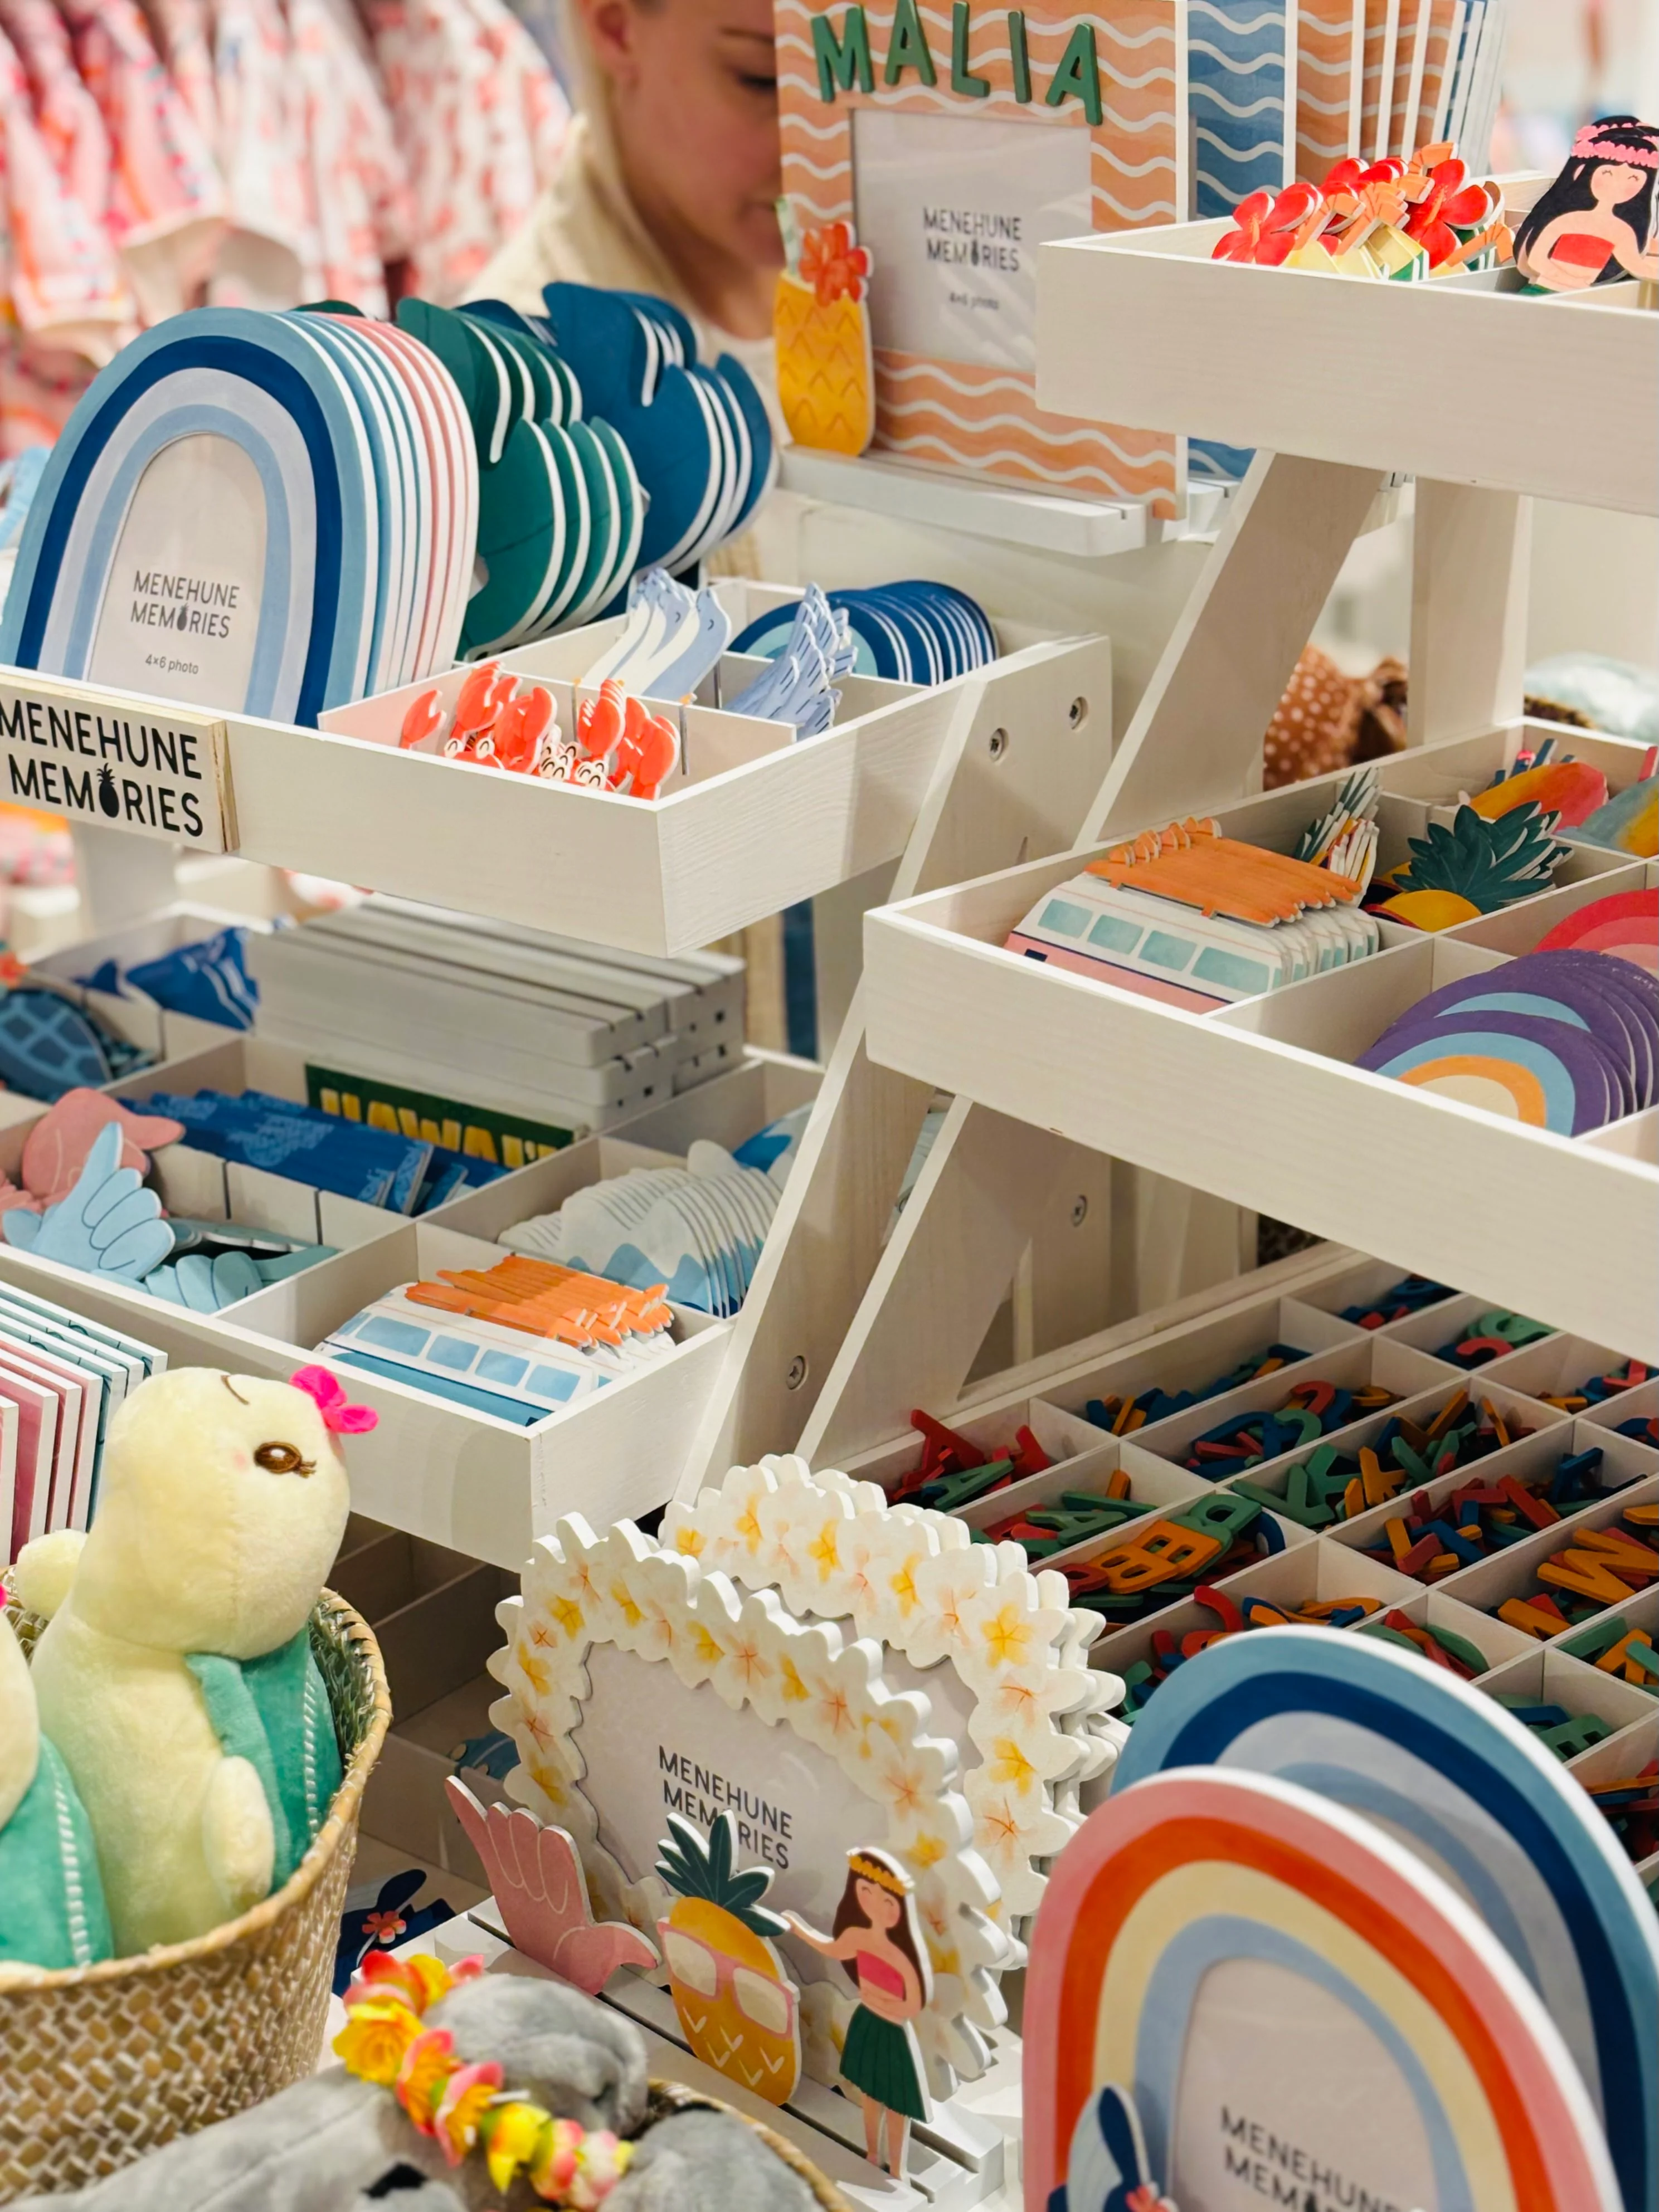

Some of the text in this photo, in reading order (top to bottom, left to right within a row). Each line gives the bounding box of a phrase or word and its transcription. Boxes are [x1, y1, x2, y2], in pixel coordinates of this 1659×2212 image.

[810, 0, 1103, 126] MALIA
[923, 207, 1022, 241] MENEHUNE
[133, 570, 240, 609] MENEHUNE
[168, 660, 199, 675] photo
[0, 699, 202, 780] MENEHUNE
[659, 1745, 792, 1840] MENEHUNE
[664, 1780, 789, 1869] MEMRIES
